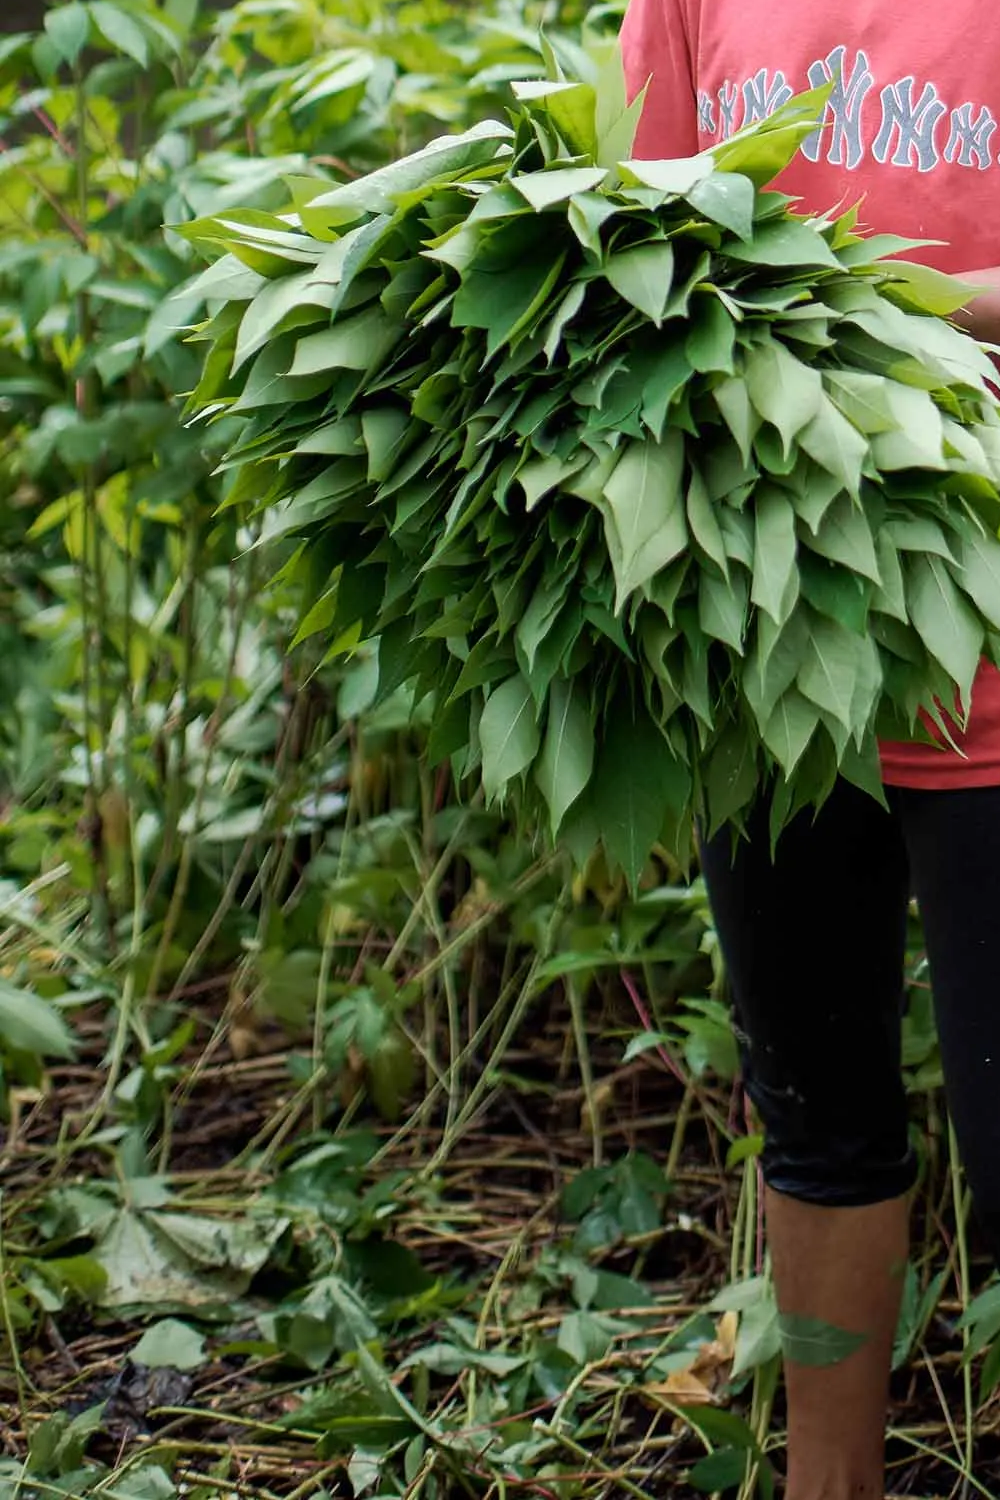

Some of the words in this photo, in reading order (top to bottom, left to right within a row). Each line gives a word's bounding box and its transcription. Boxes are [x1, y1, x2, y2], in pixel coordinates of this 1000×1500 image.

[800, 45, 875, 170] NY
[872, 76, 948, 172] NY
[943, 102, 998, 171] NY
